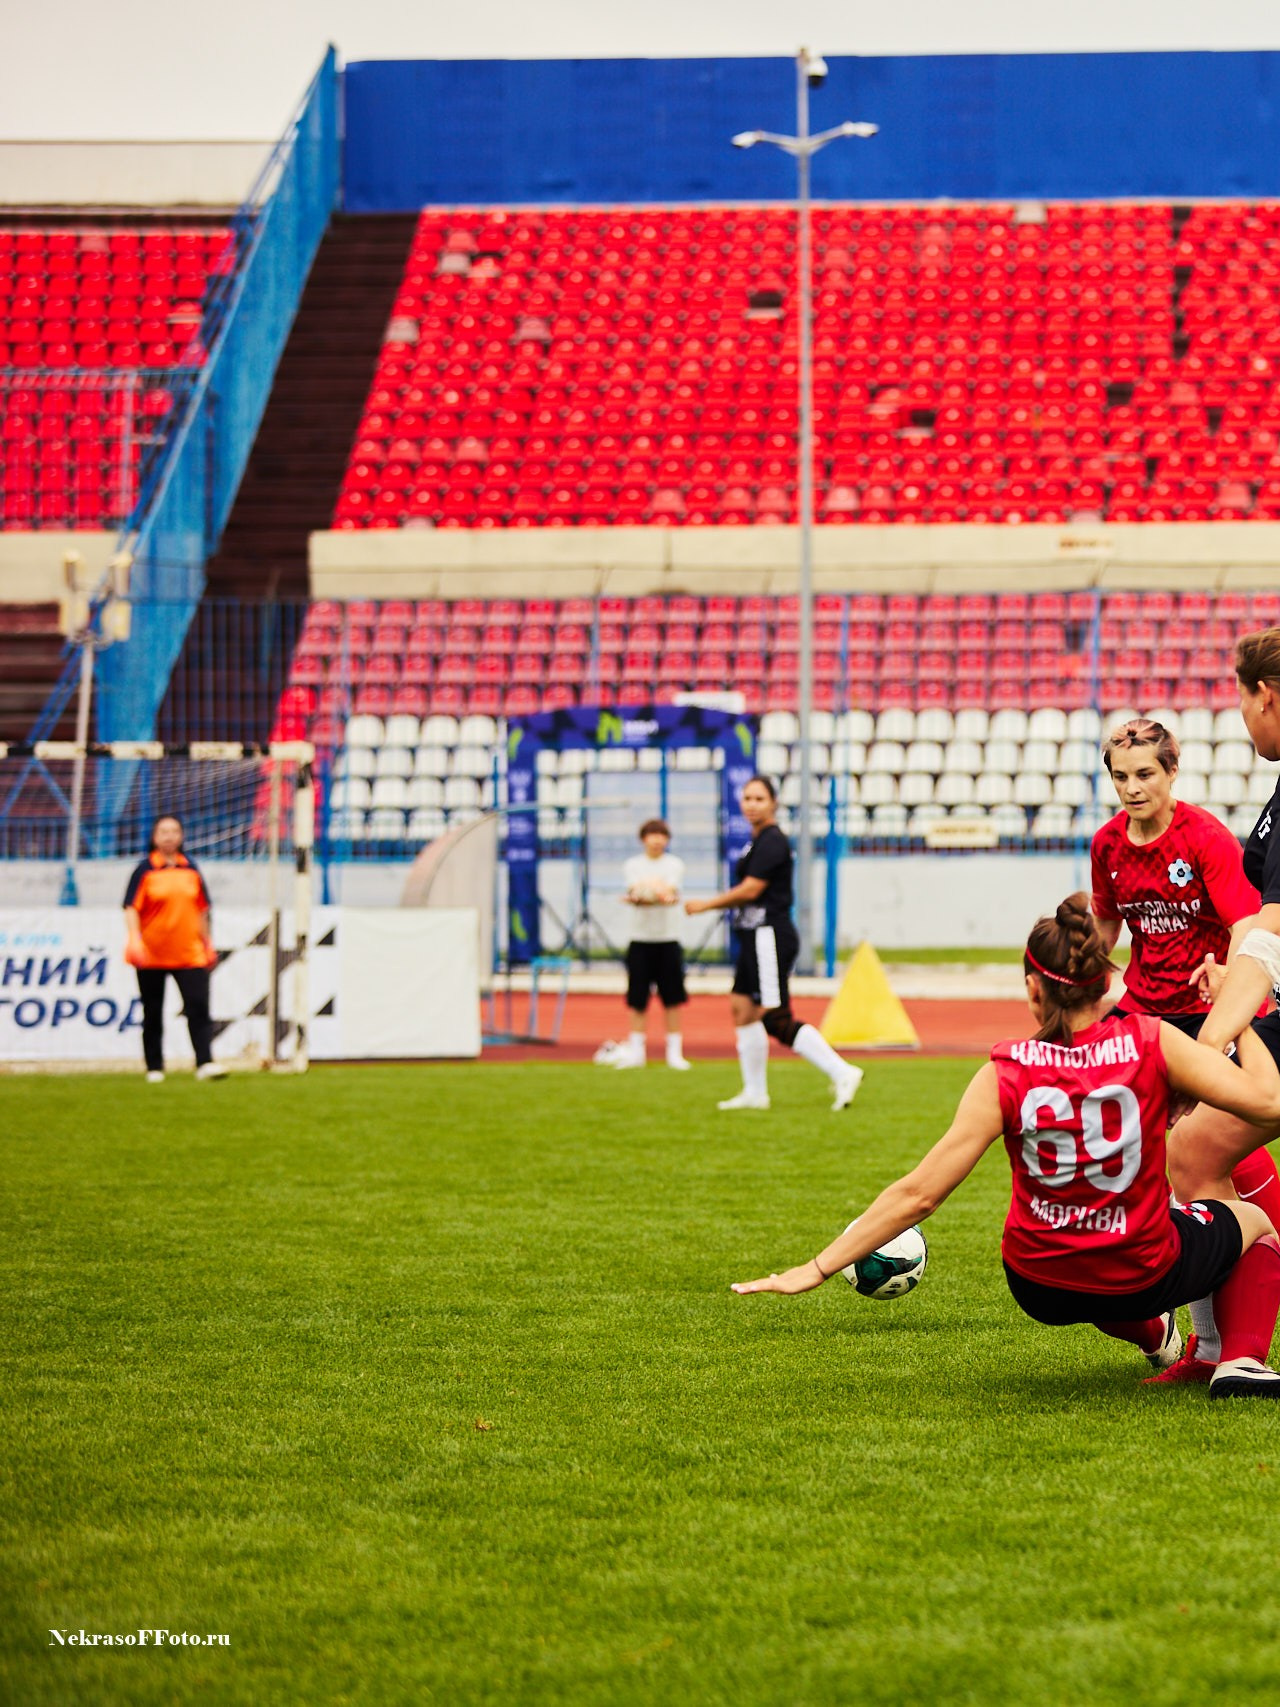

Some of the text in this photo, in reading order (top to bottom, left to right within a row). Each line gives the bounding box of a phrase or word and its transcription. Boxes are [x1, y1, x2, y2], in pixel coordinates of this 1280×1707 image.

[1139, 914, 1189, 935] МАМА!
[2, 944, 109, 987] НИЙ
[0, 997, 144, 1033] ОРОД
[1011, 1034, 1140, 1069] КАПТЮХИНА
[1020, 1084, 1142, 1194] 69
[1029, 1195, 1128, 1235] МОСКВА
